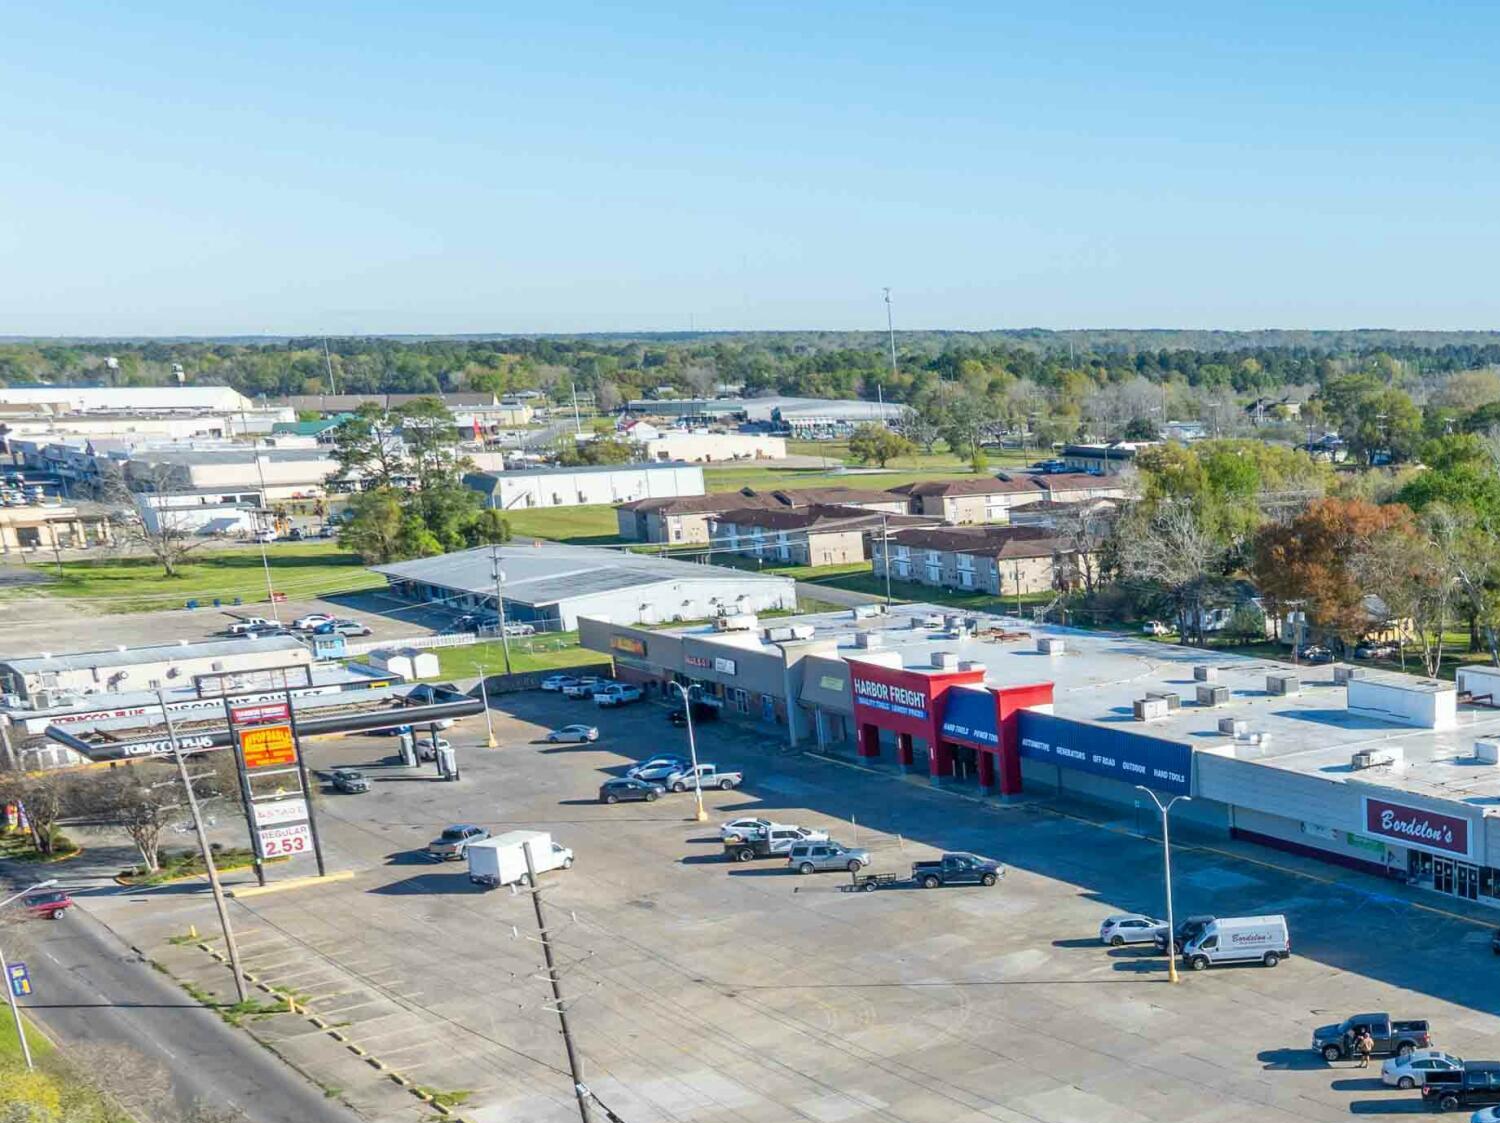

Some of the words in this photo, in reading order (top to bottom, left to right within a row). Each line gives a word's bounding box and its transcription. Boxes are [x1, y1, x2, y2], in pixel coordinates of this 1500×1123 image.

[854, 678, 888, 700] HARBOR
[889, 685, 925, 709] FREIGHT
[181, 736, 213, 748] PLUS
[1122, 762, 1146, 774] OUTDOOR
[1153, 769, 1168, 779] HAND
[1168, 772, 1185, 783] TOOLS
[262, 826, 308, 839] REGULAR
[1381, 810, 1453, 843] Bordelon's
[265, 837, 304, 856] 2.53
